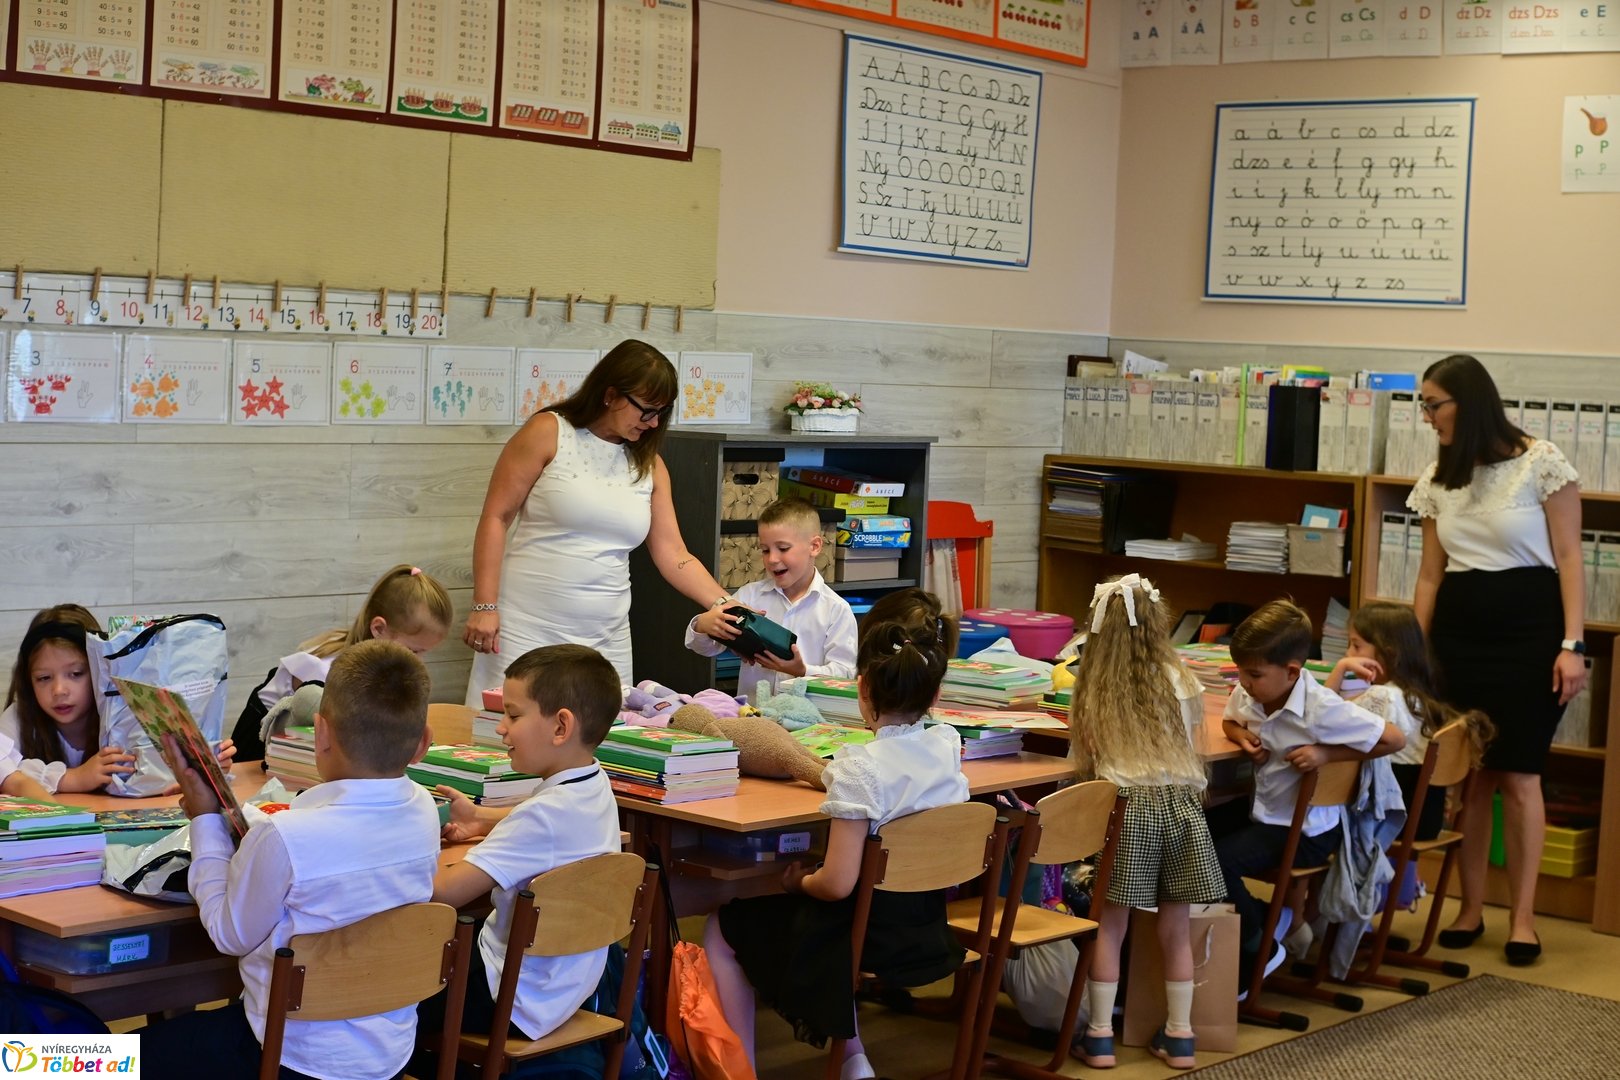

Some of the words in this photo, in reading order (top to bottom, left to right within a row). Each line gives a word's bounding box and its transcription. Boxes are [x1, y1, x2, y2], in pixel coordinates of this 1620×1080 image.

[1289, 16, 1296, 25] c
[1305, 11, 1316, 24] C
[1341, 12, 1353, 22] cs
[1359, 8, 1376, 20] Cs
[1400, 7, 1408, 20] d
[1419, 6, 1431, 20] D
[1456, 6, 1470, 20] dz
[1474, 6, 1492, 19] Dz
[1509, 6, 1529, 20] dzs
[1534, 5, 1558, 18] Dzs
[1580, 8, 1589, 18] e
[1597, 5, 1606, 18] E
[1233, 16, 1240, 28] b
[1251, 15, 1259, 27] B
[1148, 27, 1159, 38] A
[1600, 140, 1609, 154] P
[22, 298, 31, 314] 7
[56, 300, 65, 316] 8
[90, 300, 100, 316] 9
[121, 302, 139, 318] 10
[153, 304, 169, 319] 11
[184, 305, 203, 321] 12
[218, 306, 234, 322] 13
[249, 308, 264, 323] 14
[280, 309, 296, 324] 15
[310, 310, 325, 325] 16
[338, 311, 354, 326] 17
[366, 313, 382, 327] 18
[395, 314, 410, 328] 19
[421, 315, 437, 329] 20
[31, 350, 41, 366] 3
[144, 354, 154, 368] 4
[251, 359, 261, 373] 5
[350, 360, 359, 373] 6
[444, 362, 452, 376] 7
[532, 365, 539, 378] 8
[690, 366, 701, 378] 10
[854, 534, 882, 543] SCRABBLE
